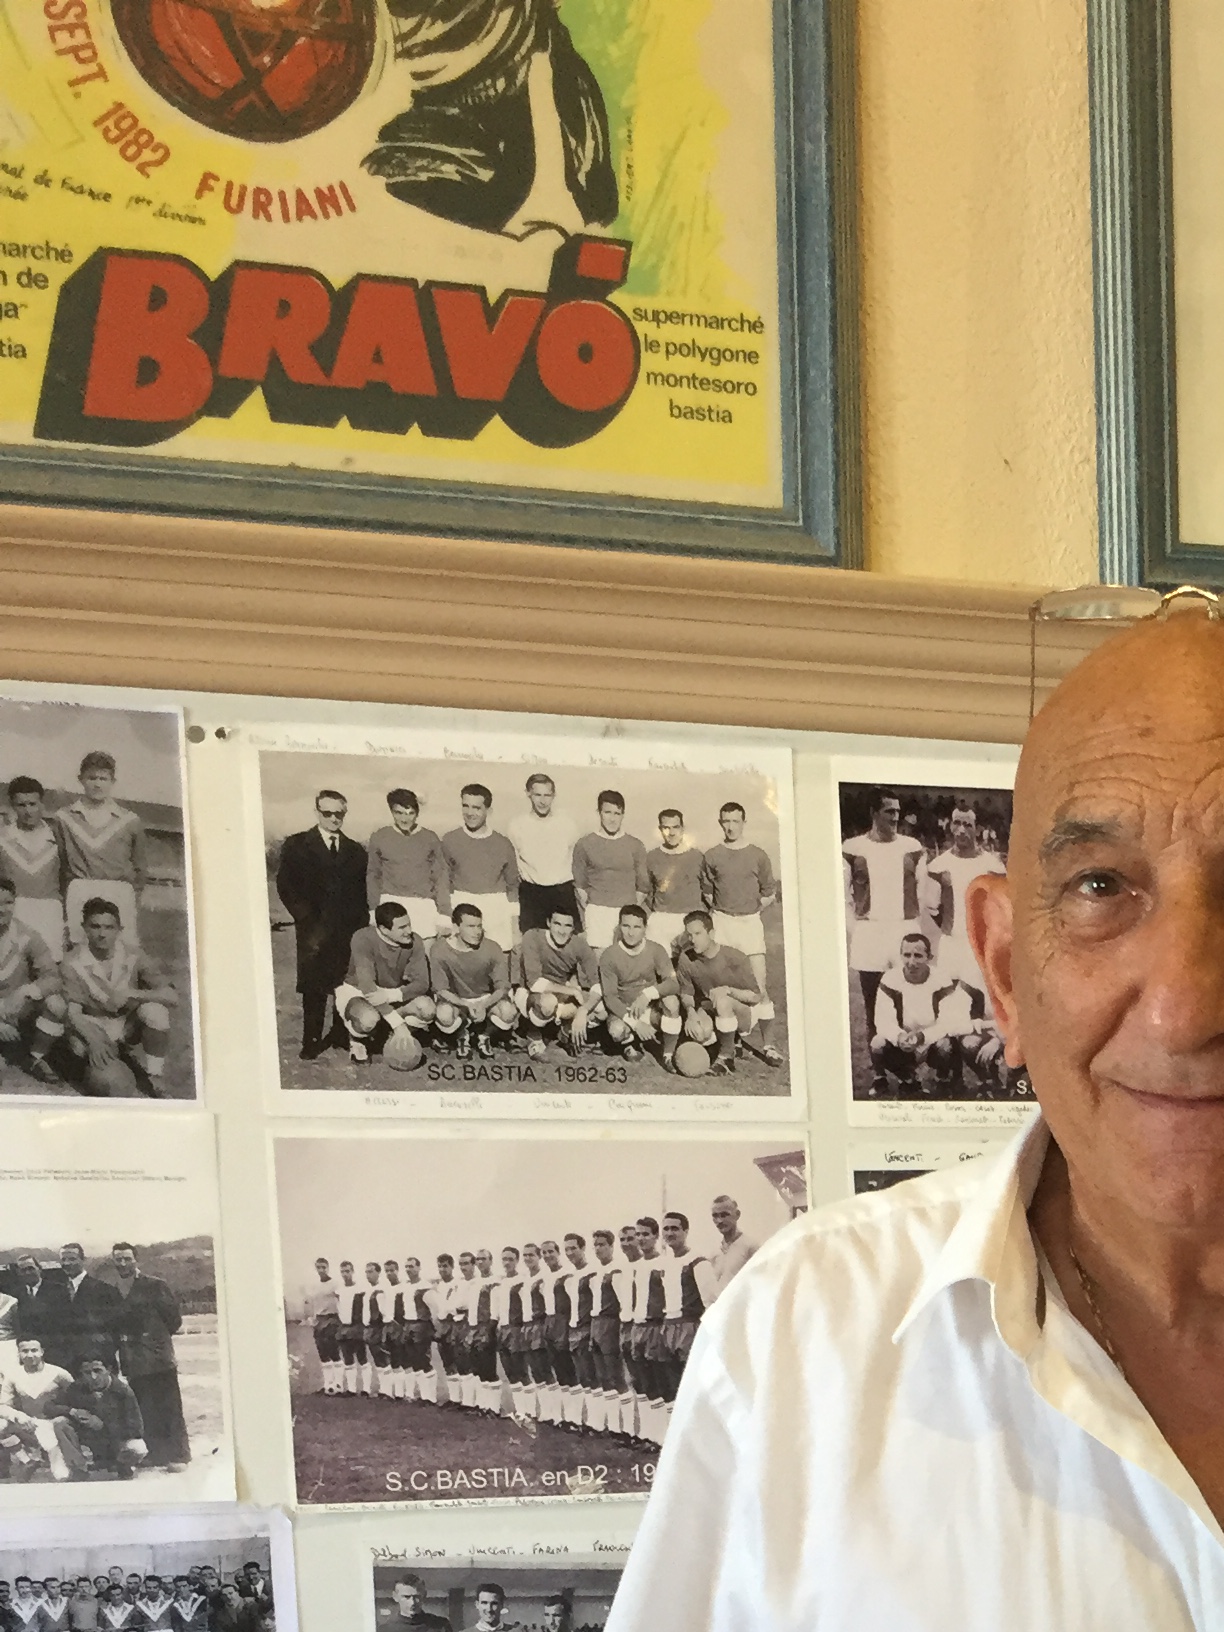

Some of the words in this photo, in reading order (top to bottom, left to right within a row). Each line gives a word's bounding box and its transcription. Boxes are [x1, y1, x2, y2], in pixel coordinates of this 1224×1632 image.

[92, 101, 171, 179] 1982
[195, 170, 357, 223] FURIANI
[16, 266, 49, 290] de
[633, 306, 764, 335] supermarché
[644, 334, 661, 354] le
[665, 339, 760, 366] polygone
[646, 371, 758, 396] montesoro
[669, 398, 733, 424] bastia
[554, 1067, 628, 1083] 1962-63
[541, 1470, 569, 1486] en
[577, 1464, 608, 1485] D2
